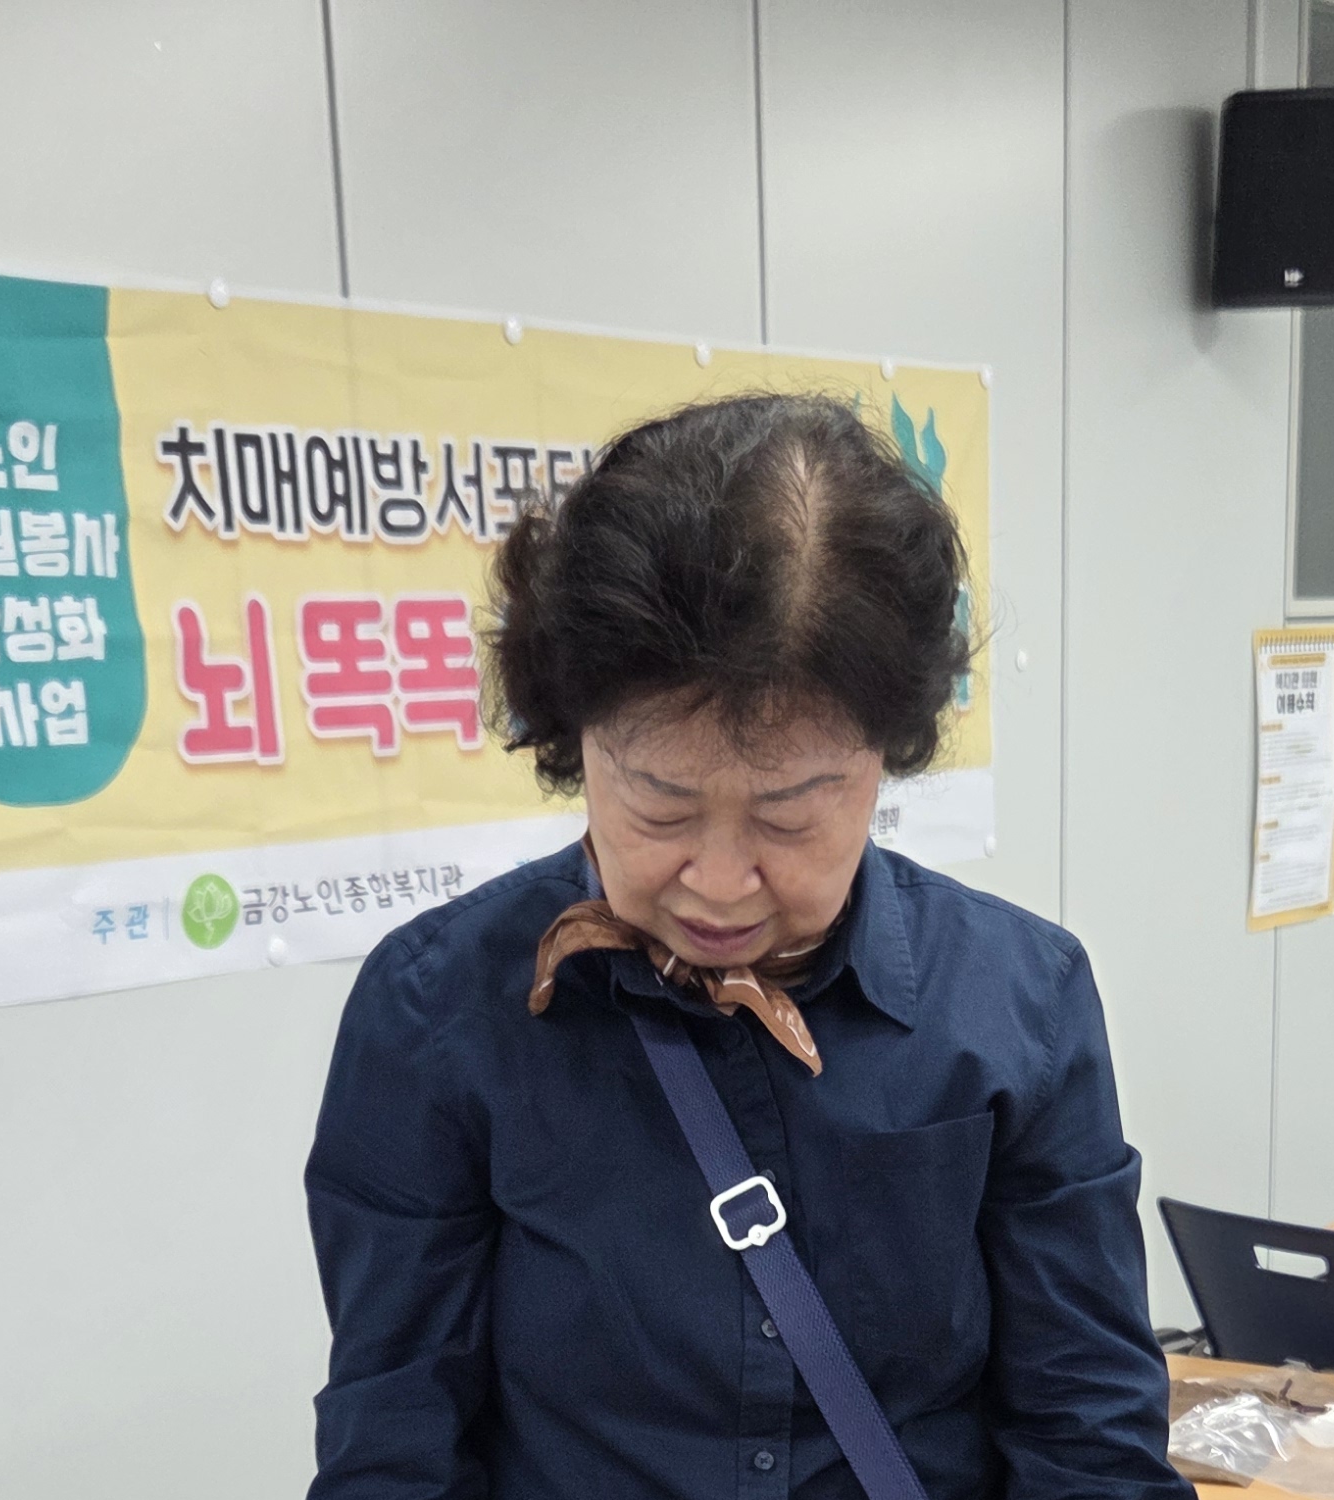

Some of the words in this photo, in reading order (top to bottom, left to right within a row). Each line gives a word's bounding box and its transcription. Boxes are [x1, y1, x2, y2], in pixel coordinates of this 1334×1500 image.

[178, 598, 282, 757] 뇌
[302, 599, 479, 750] 똑똑
[242, 864, 466, 926] 금강노인종합복지관
